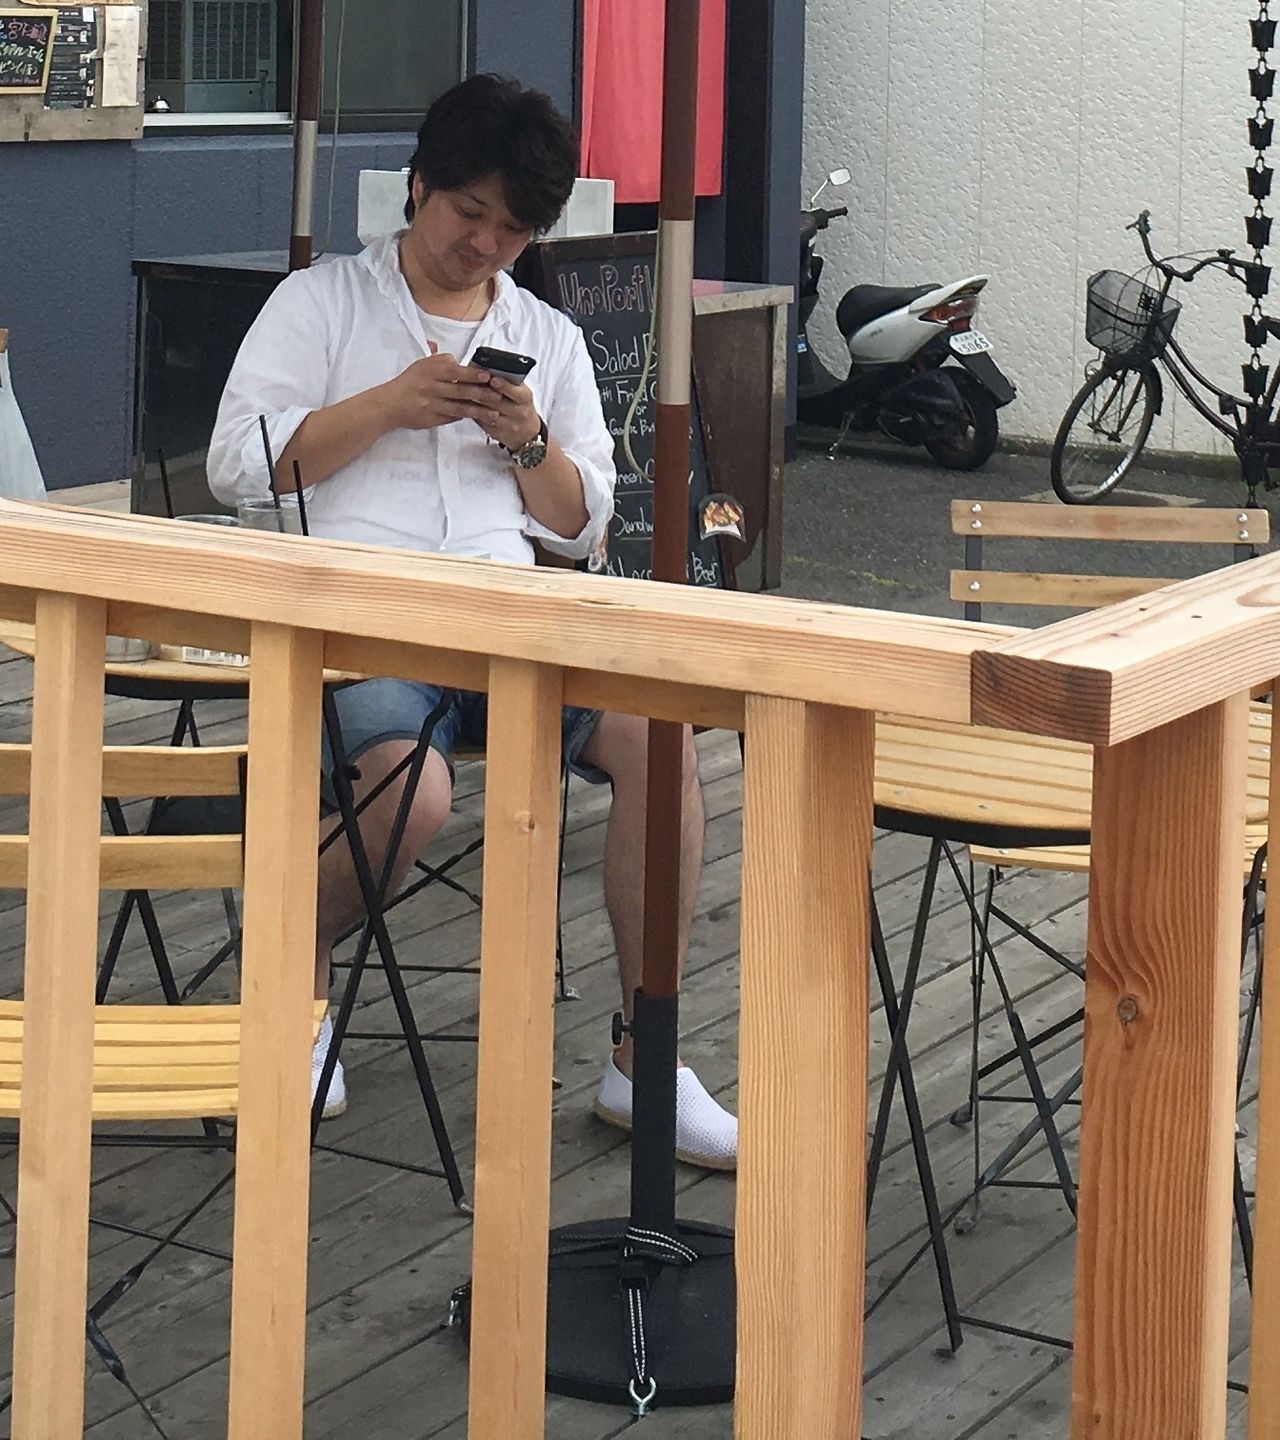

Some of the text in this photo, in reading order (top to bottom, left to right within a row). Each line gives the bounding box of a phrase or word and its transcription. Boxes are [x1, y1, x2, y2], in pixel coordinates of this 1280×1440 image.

[591, 329, 640, 373] Salad
[615, 379, 649, 405] Frid
[635, 405, 648, 416] or
[616, 472, 643, 485] reen
